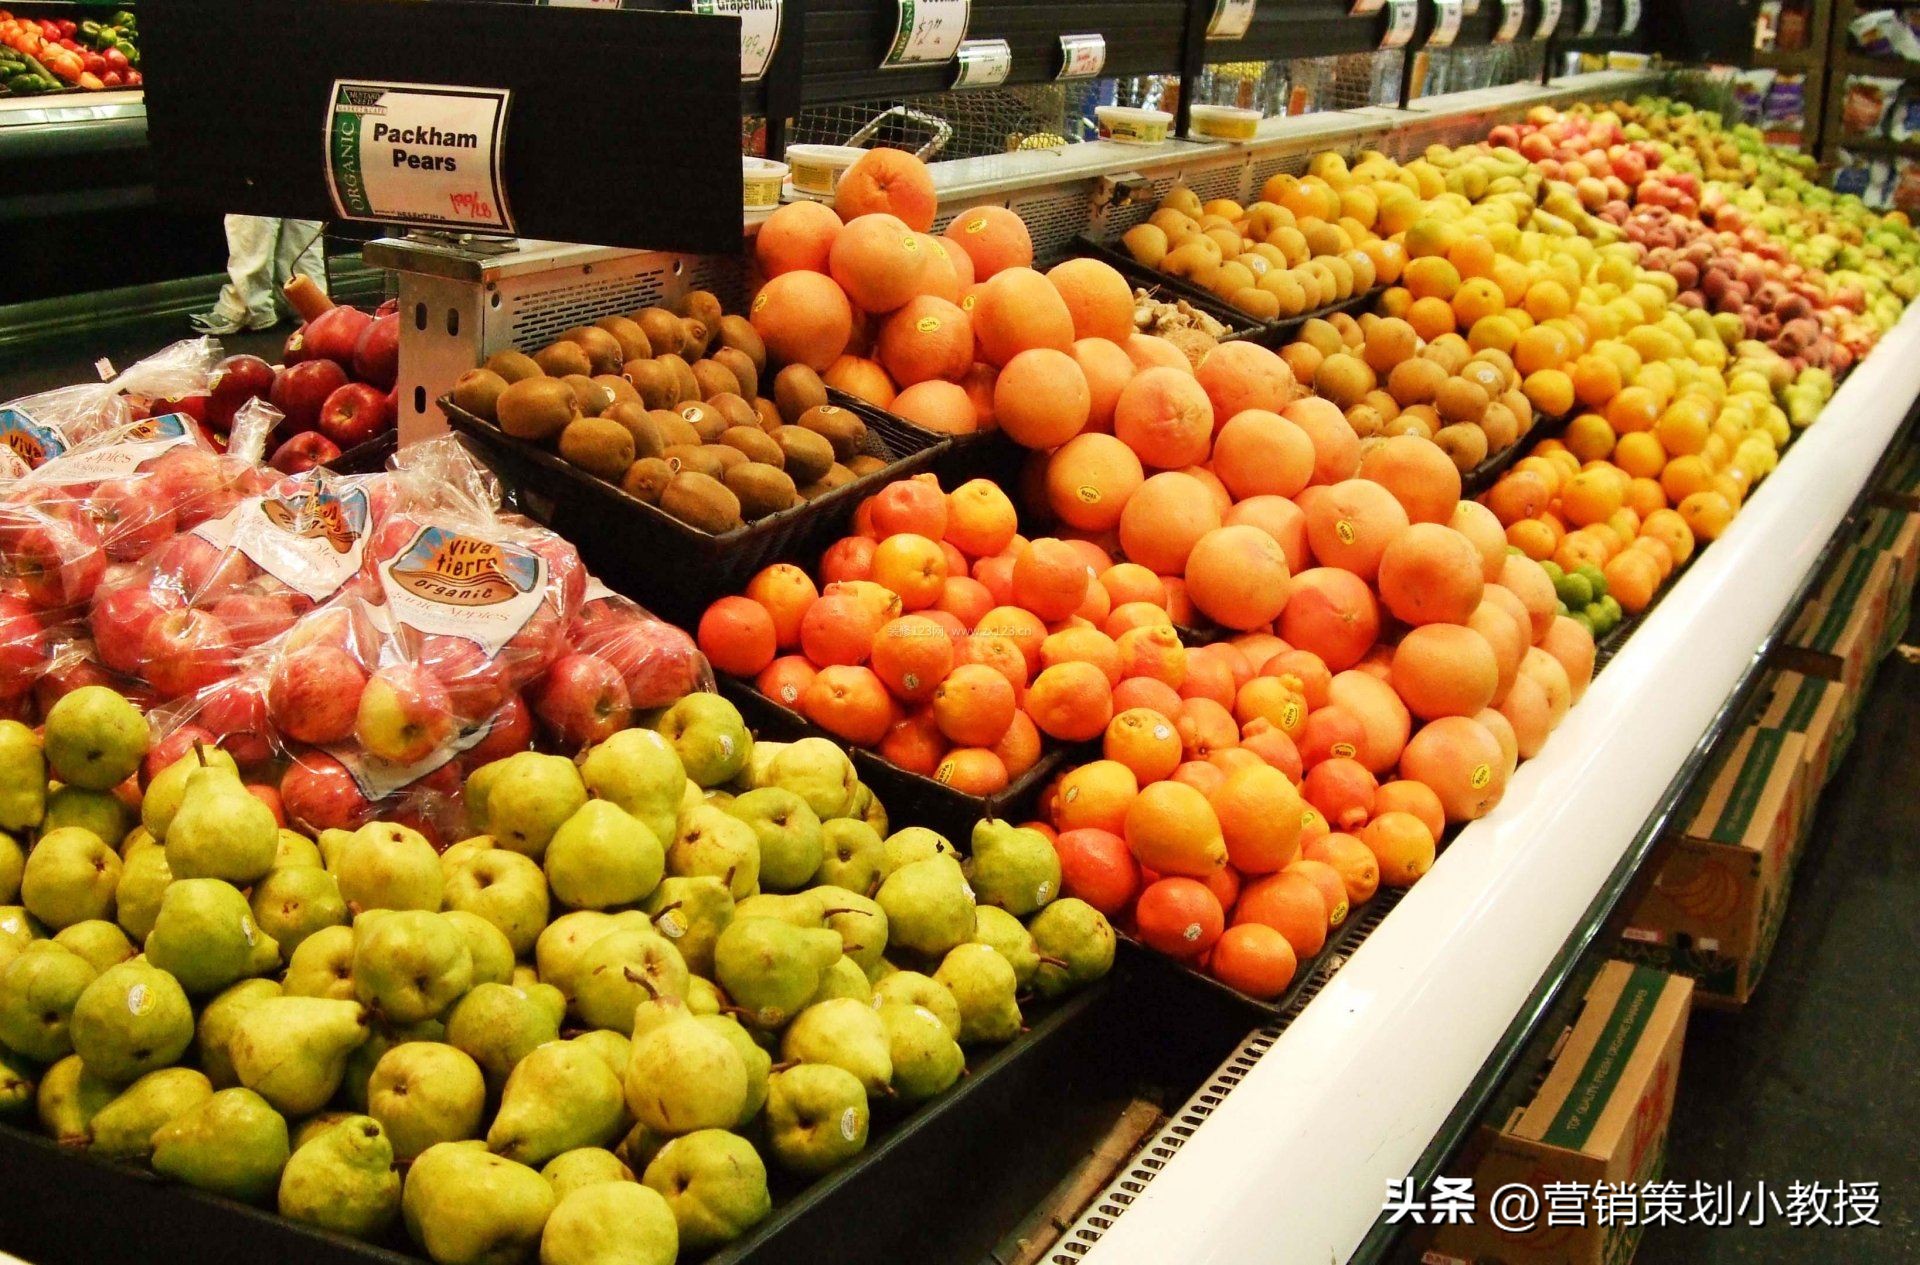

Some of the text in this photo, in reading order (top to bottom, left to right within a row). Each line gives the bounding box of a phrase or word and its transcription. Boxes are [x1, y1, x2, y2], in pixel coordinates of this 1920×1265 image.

[373, 123, 477, 149] Packham
[341, 122, 365, 211] ORGANIC
[392, 148, 457, 172] Pears
[436, 553, 498, 577] tierra
[414, 580, 493, 599] organic
